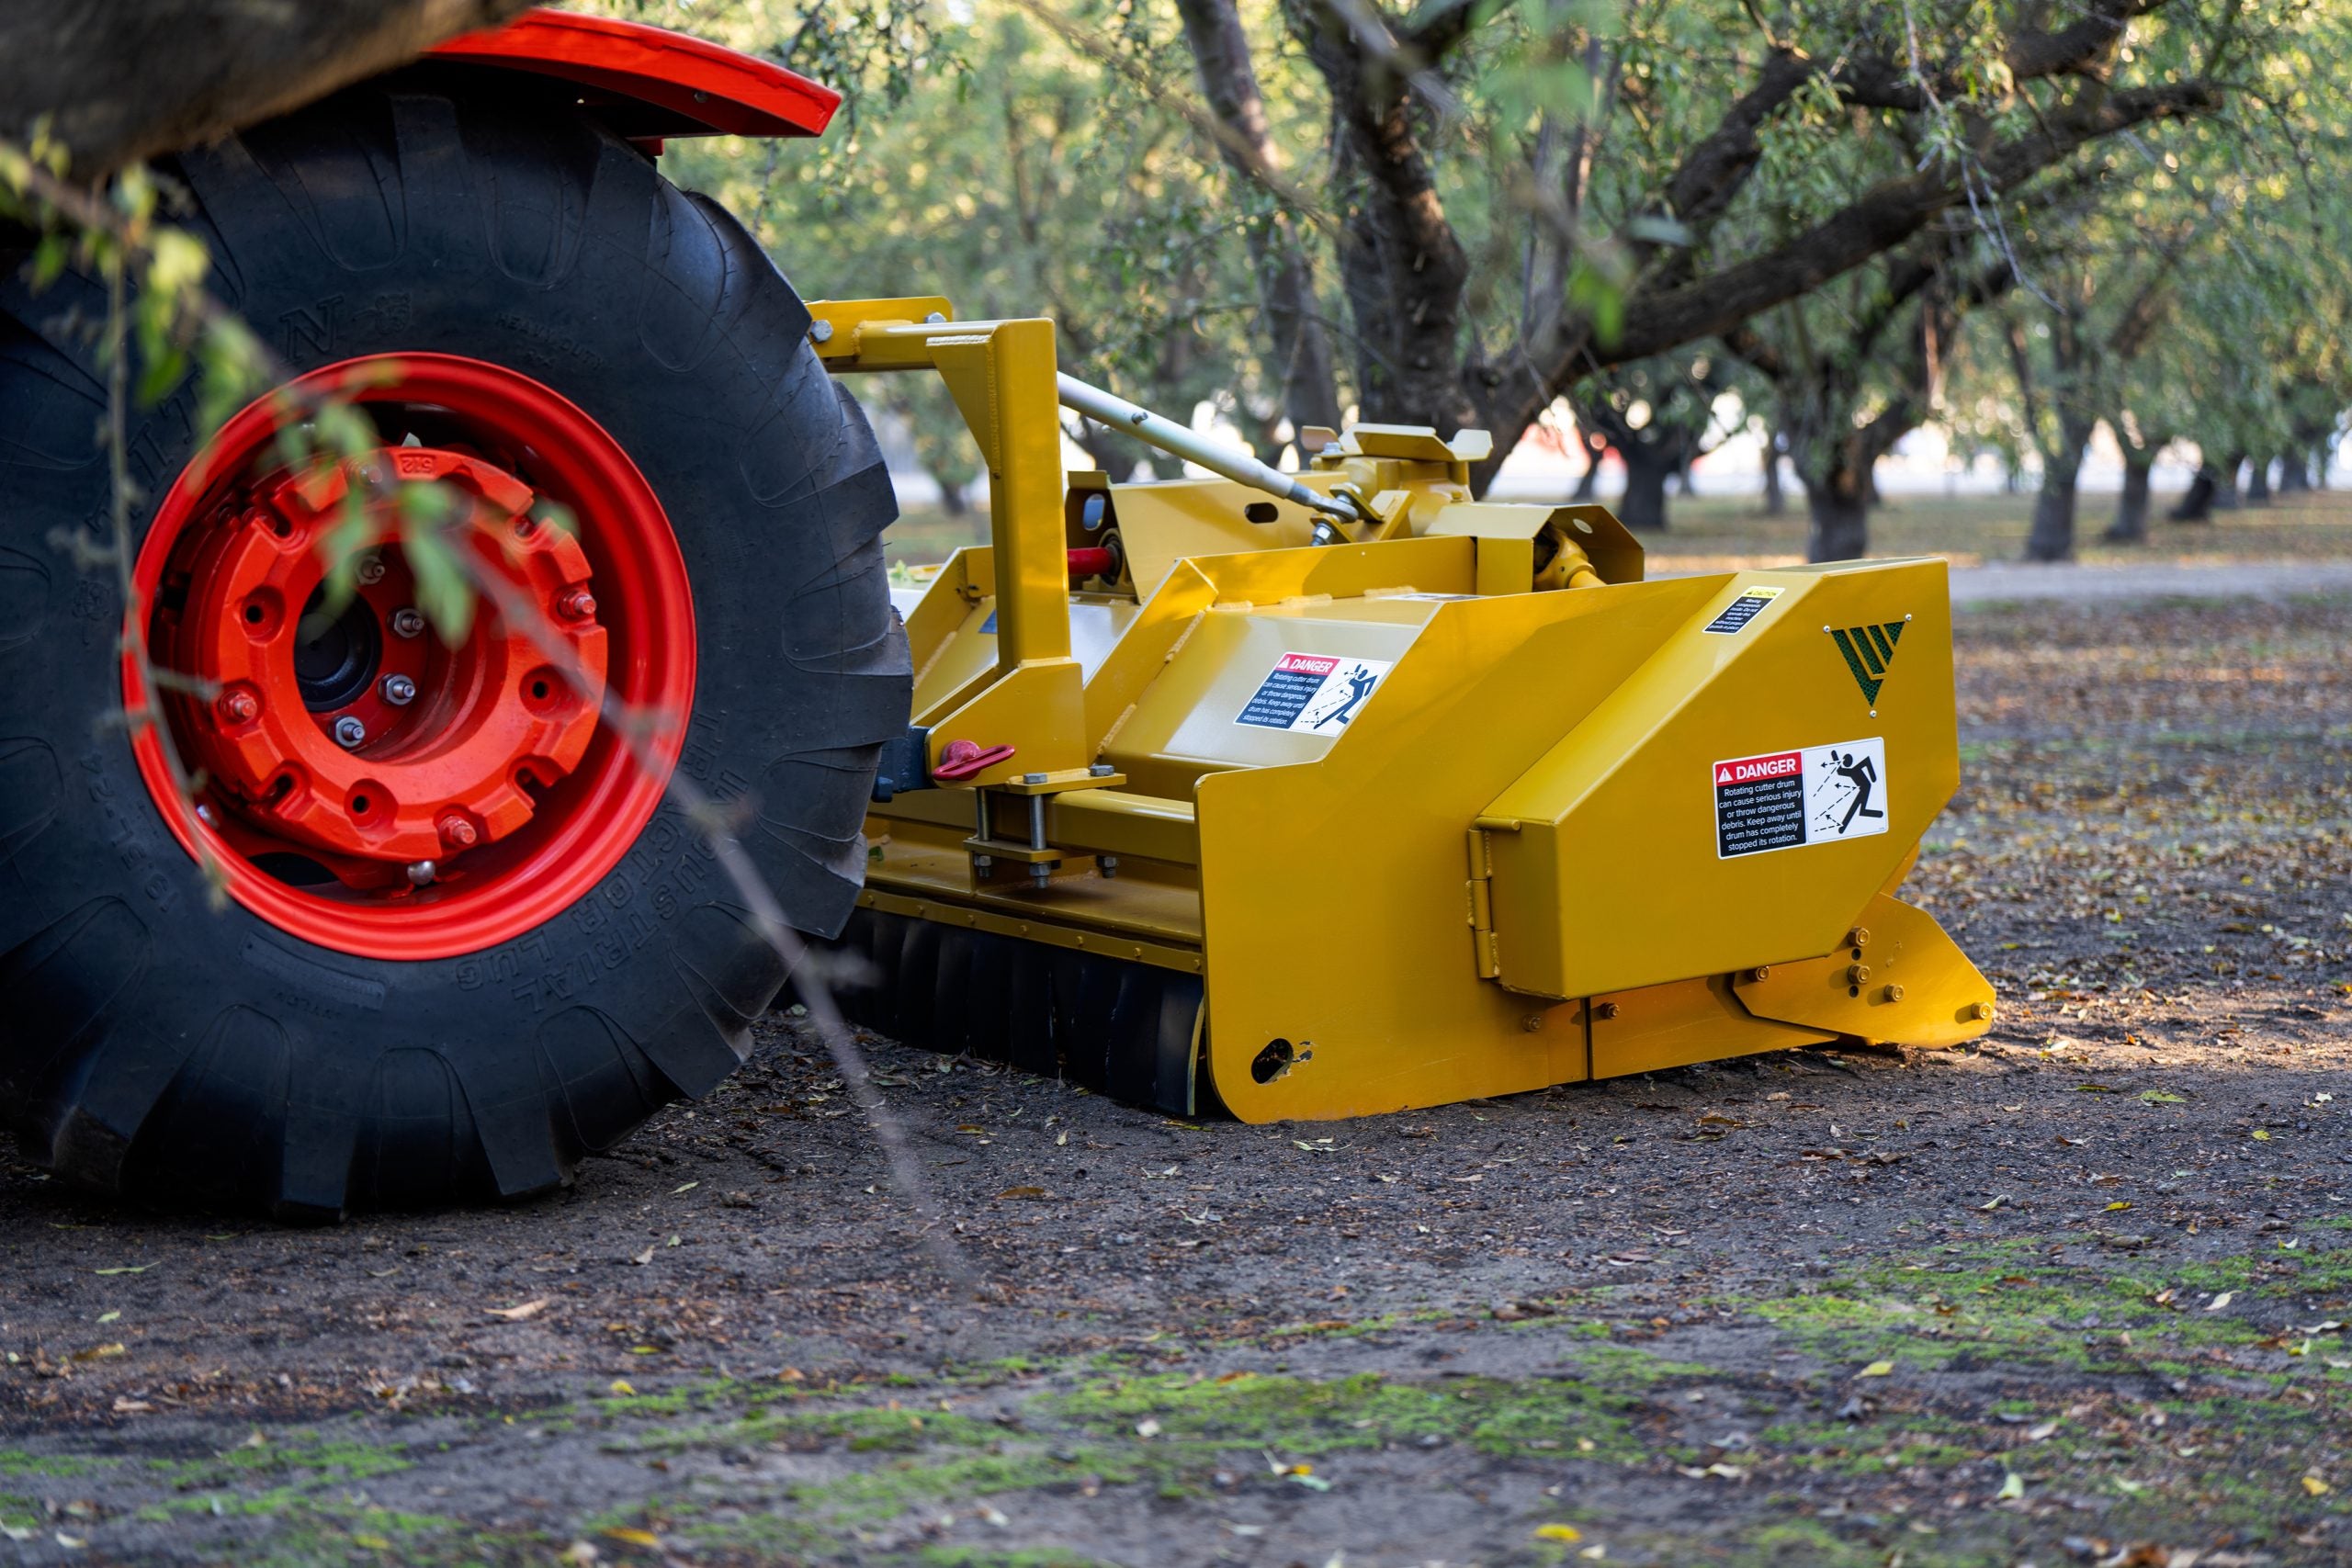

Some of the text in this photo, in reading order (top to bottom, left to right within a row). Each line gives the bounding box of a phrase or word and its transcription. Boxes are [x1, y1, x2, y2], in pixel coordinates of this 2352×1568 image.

[85, 294, 345, 533] TITN
[1290, 658, 1333, 673] DANGER
[1272, 673, 1293, 682] Rotating
[1736, 758, 1796, 780] DANGER
[1724, 780, 1795, 797] Rotating cutter drum
[1733, 797, 1754, 807] cause
[1755, 793, 1781, 803] serious
[1782, 790, 1802, 800] injury
[1736, 808, 1756, 817] throw
[1757, 802, 1795, 813] dangerous
[571, 708, 728, 935] TRCTOR
[1721, 810, 1802, 830] debris. Keep away until
[79, 751, 179, 914] 19.5L-24
[1726, 831, 1745, 840] drum
[1760, 823, 1798, 835] completely
[1728, 839, 1758, 851] stopped
[1768, 834, 1798, 844] rotation.
[456, 929, 555, 992] LUG
